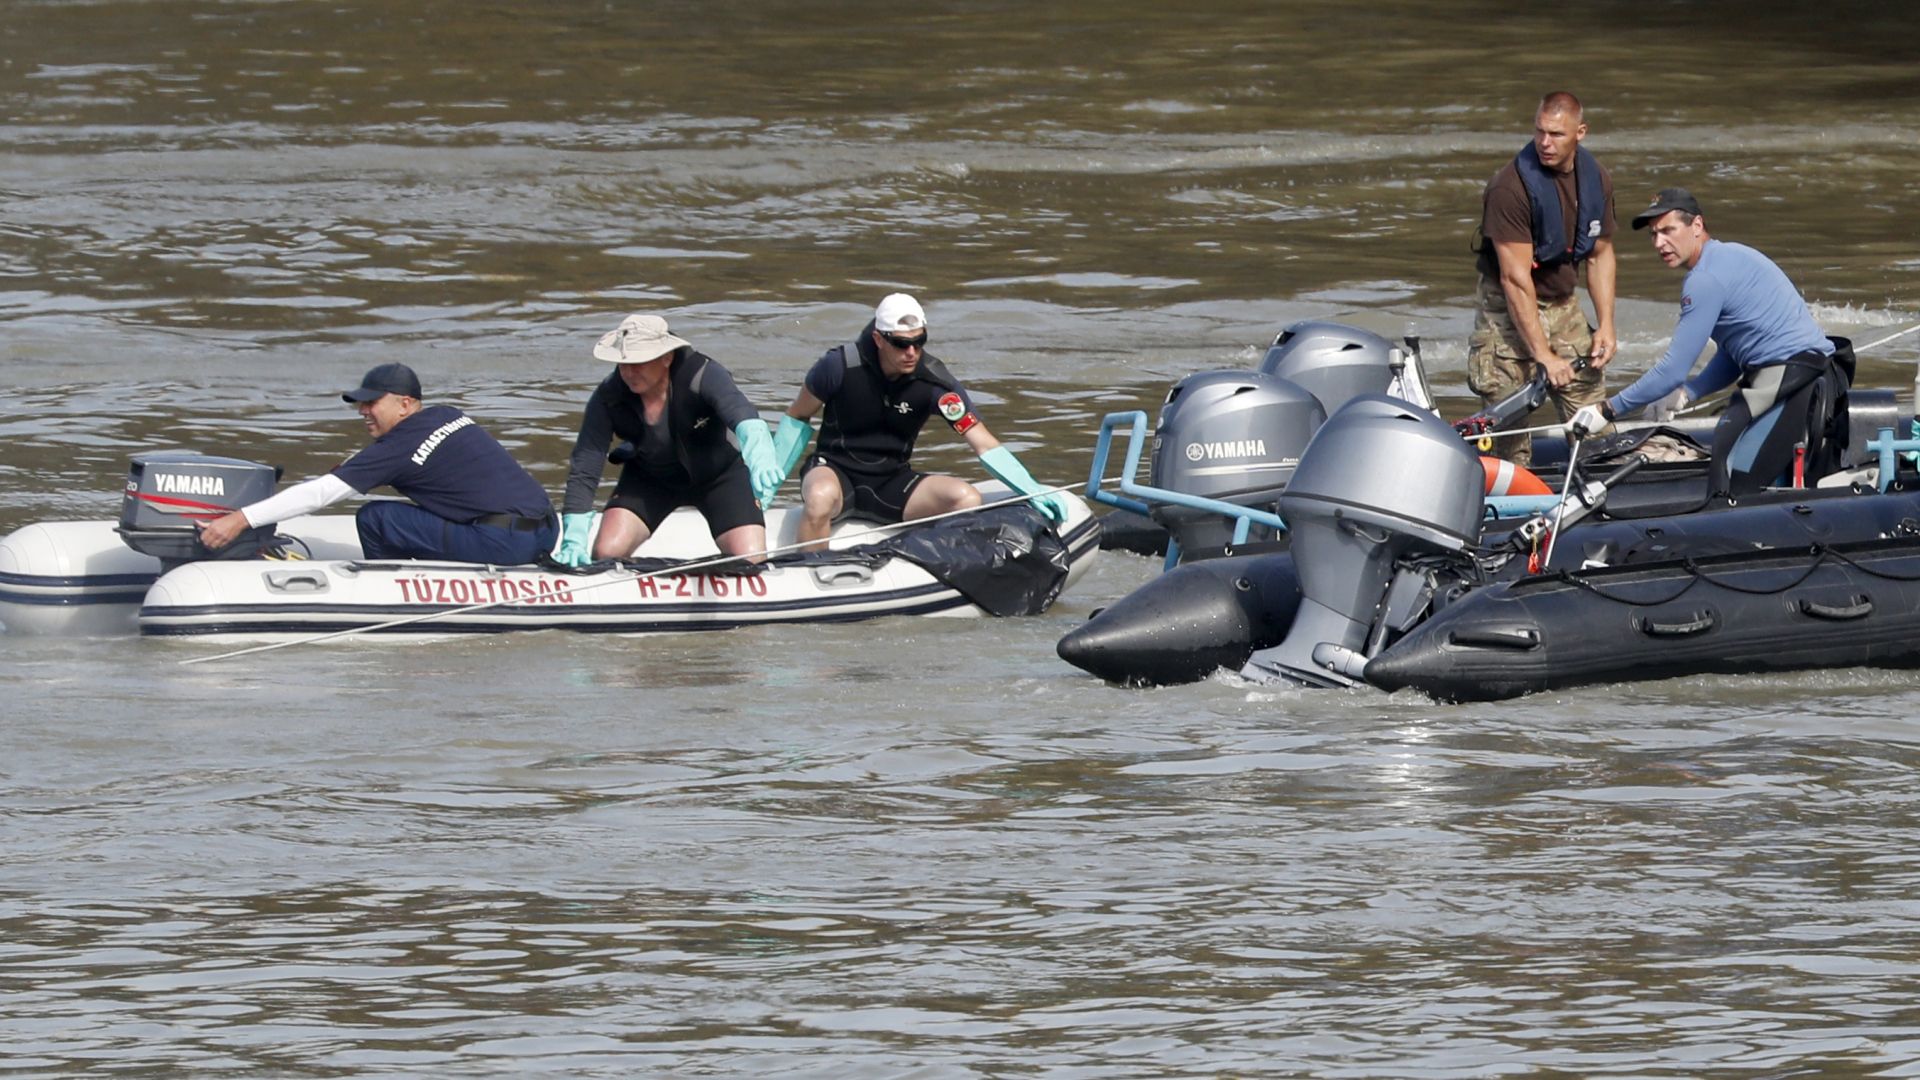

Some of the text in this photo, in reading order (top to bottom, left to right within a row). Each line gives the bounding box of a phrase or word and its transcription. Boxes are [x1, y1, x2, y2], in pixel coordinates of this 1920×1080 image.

[1204, 439, 1266, 460] YAMAHA
[155, 473, 225, 496] YAMAHA
[394, 573, 768, 604] TŰZOLTÓSÁG H-27670
